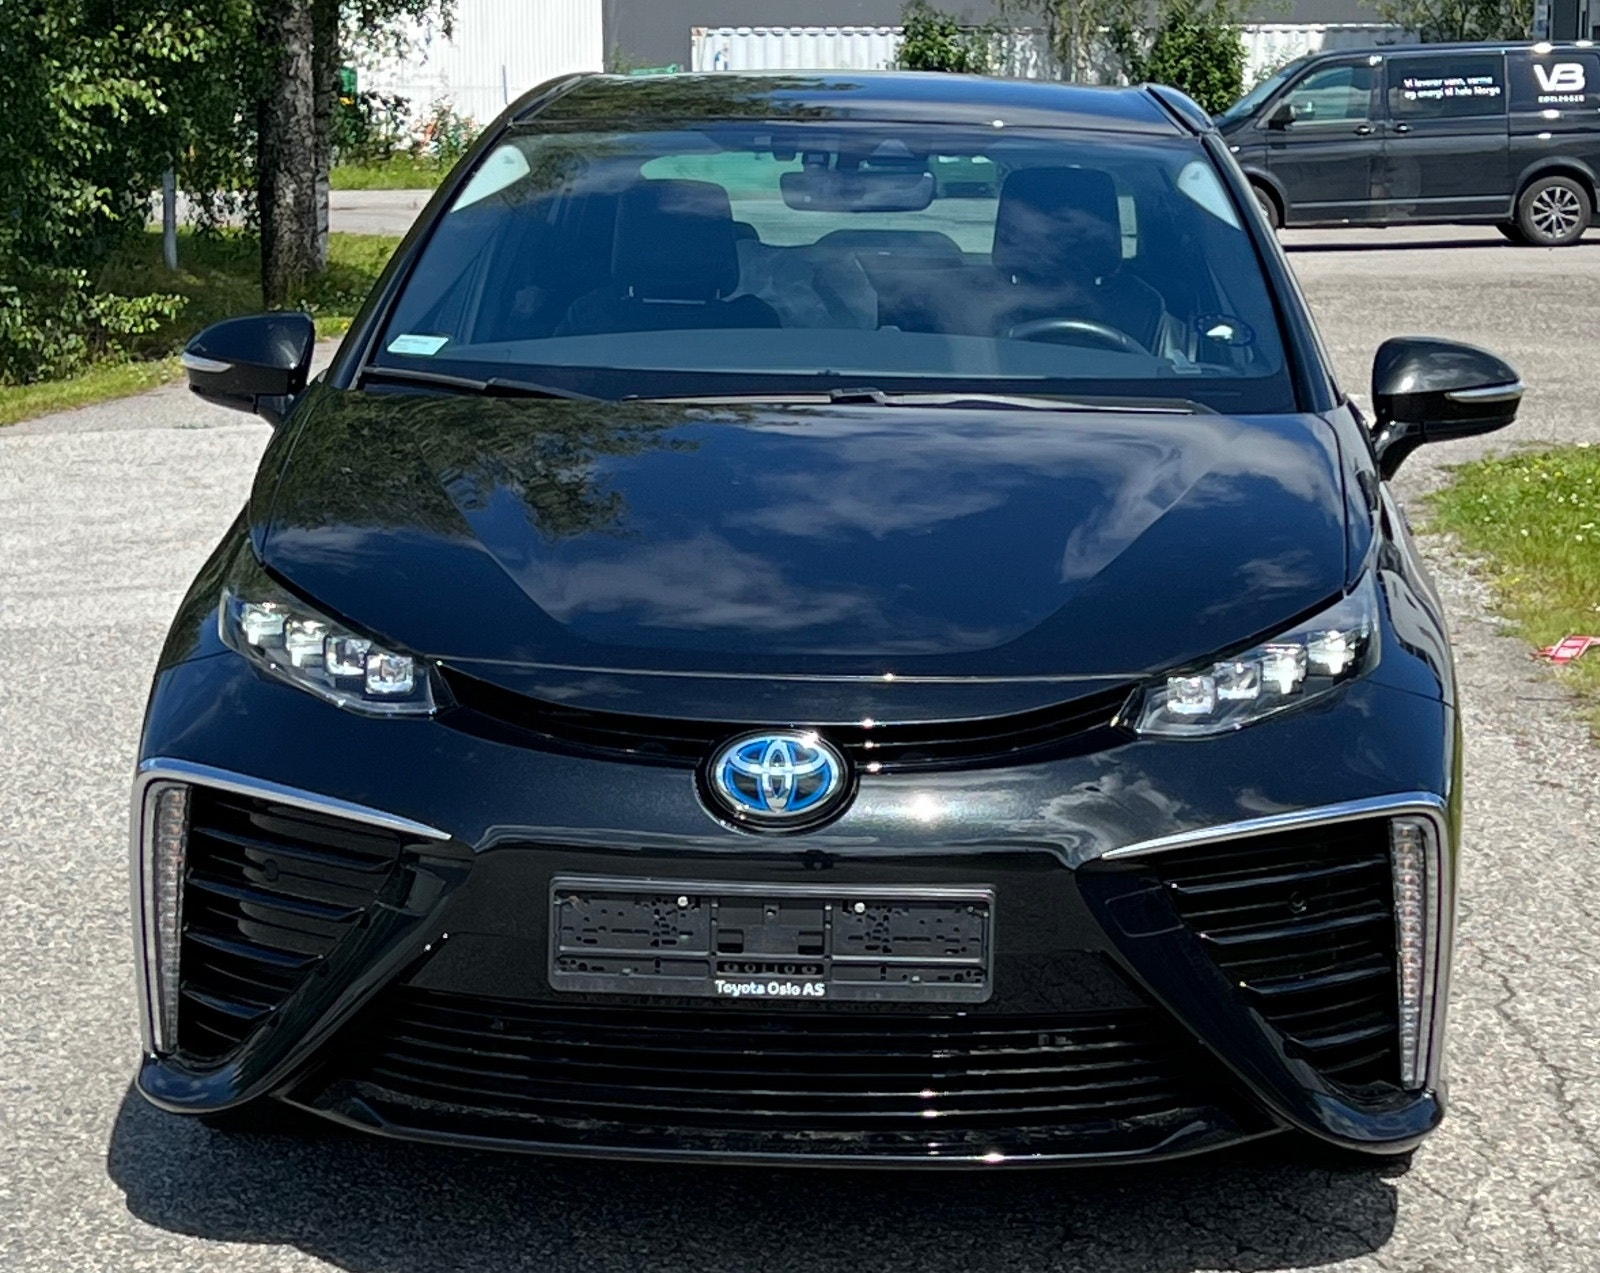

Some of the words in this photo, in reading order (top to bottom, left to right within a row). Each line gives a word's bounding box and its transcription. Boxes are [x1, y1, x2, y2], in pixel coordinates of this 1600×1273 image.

[1533, 63, 1586, 92] VB
[714, 979, 766, 997] Toyota
[767, 981, 801, 996] Oslo
[802, 982, 826, 997] AS
